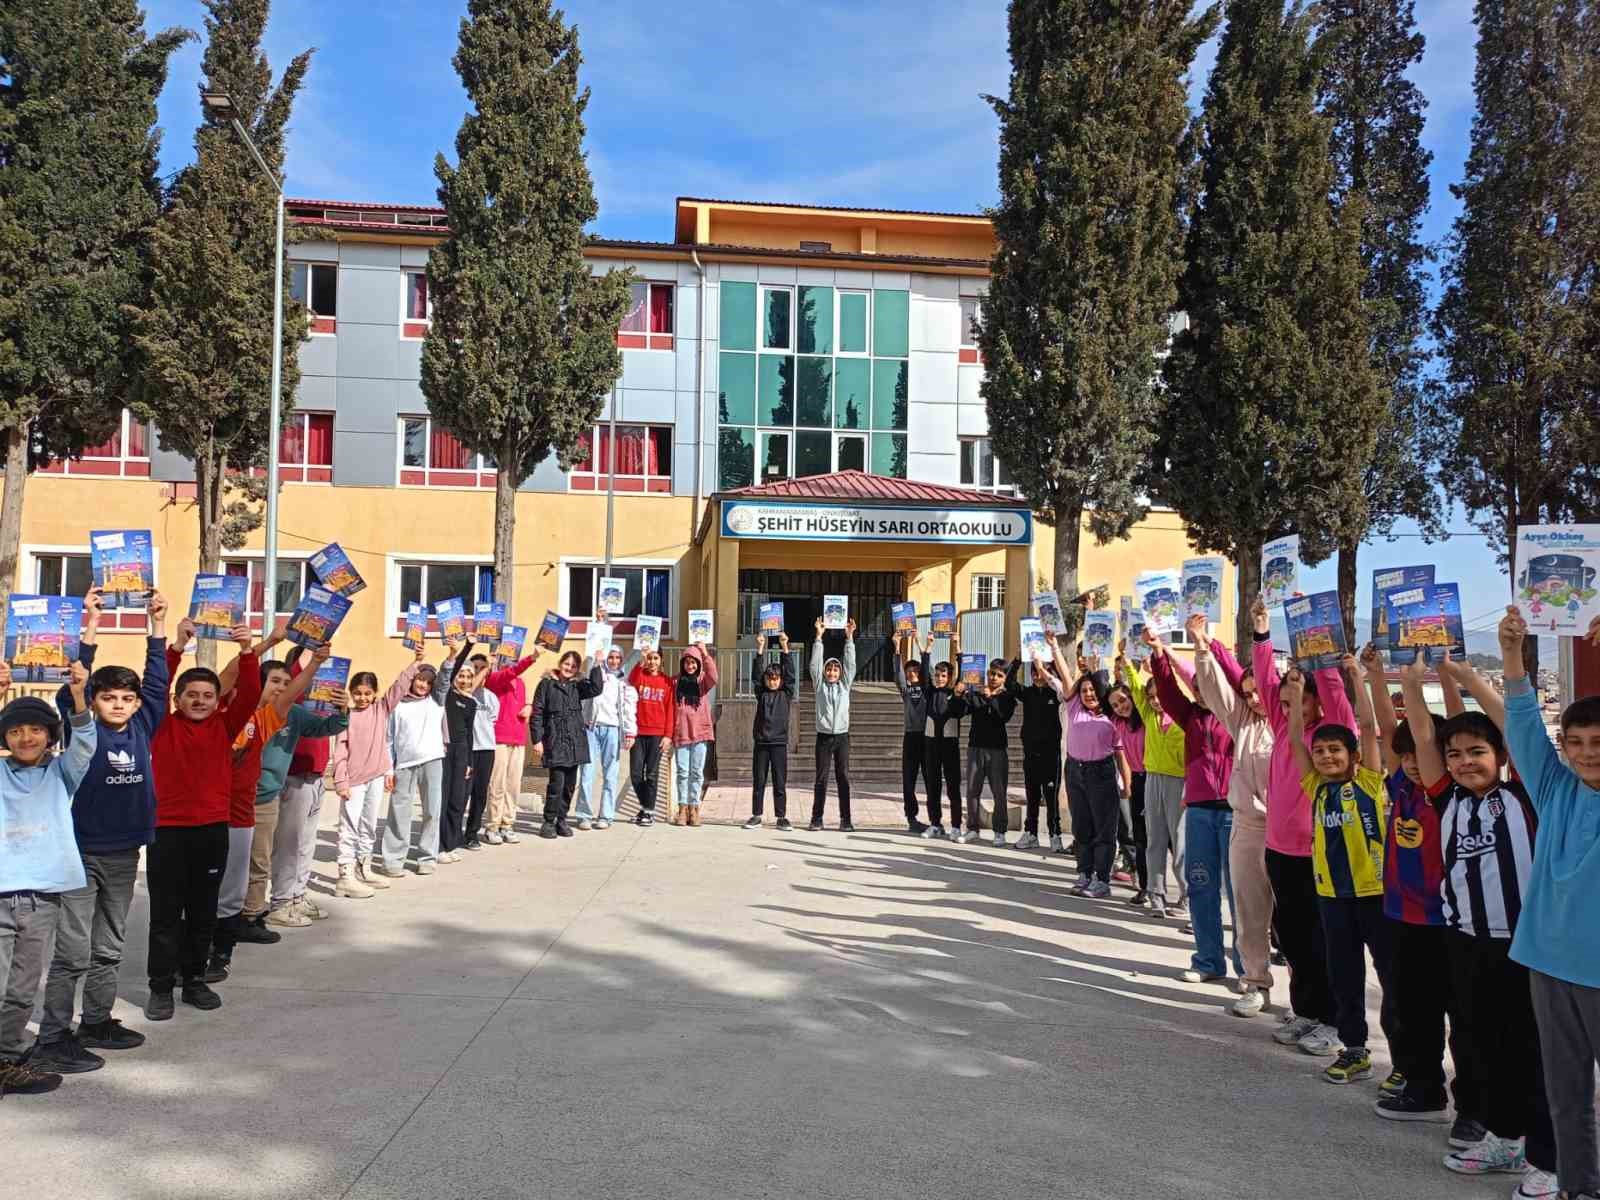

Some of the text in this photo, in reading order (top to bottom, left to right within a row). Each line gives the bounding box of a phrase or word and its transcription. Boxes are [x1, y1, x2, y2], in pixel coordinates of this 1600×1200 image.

[757, 515, 1013, 536] ŞEHİT HÜSEYİN SARI ORTAOKULU
[105, 774, 144, 785] adidas
